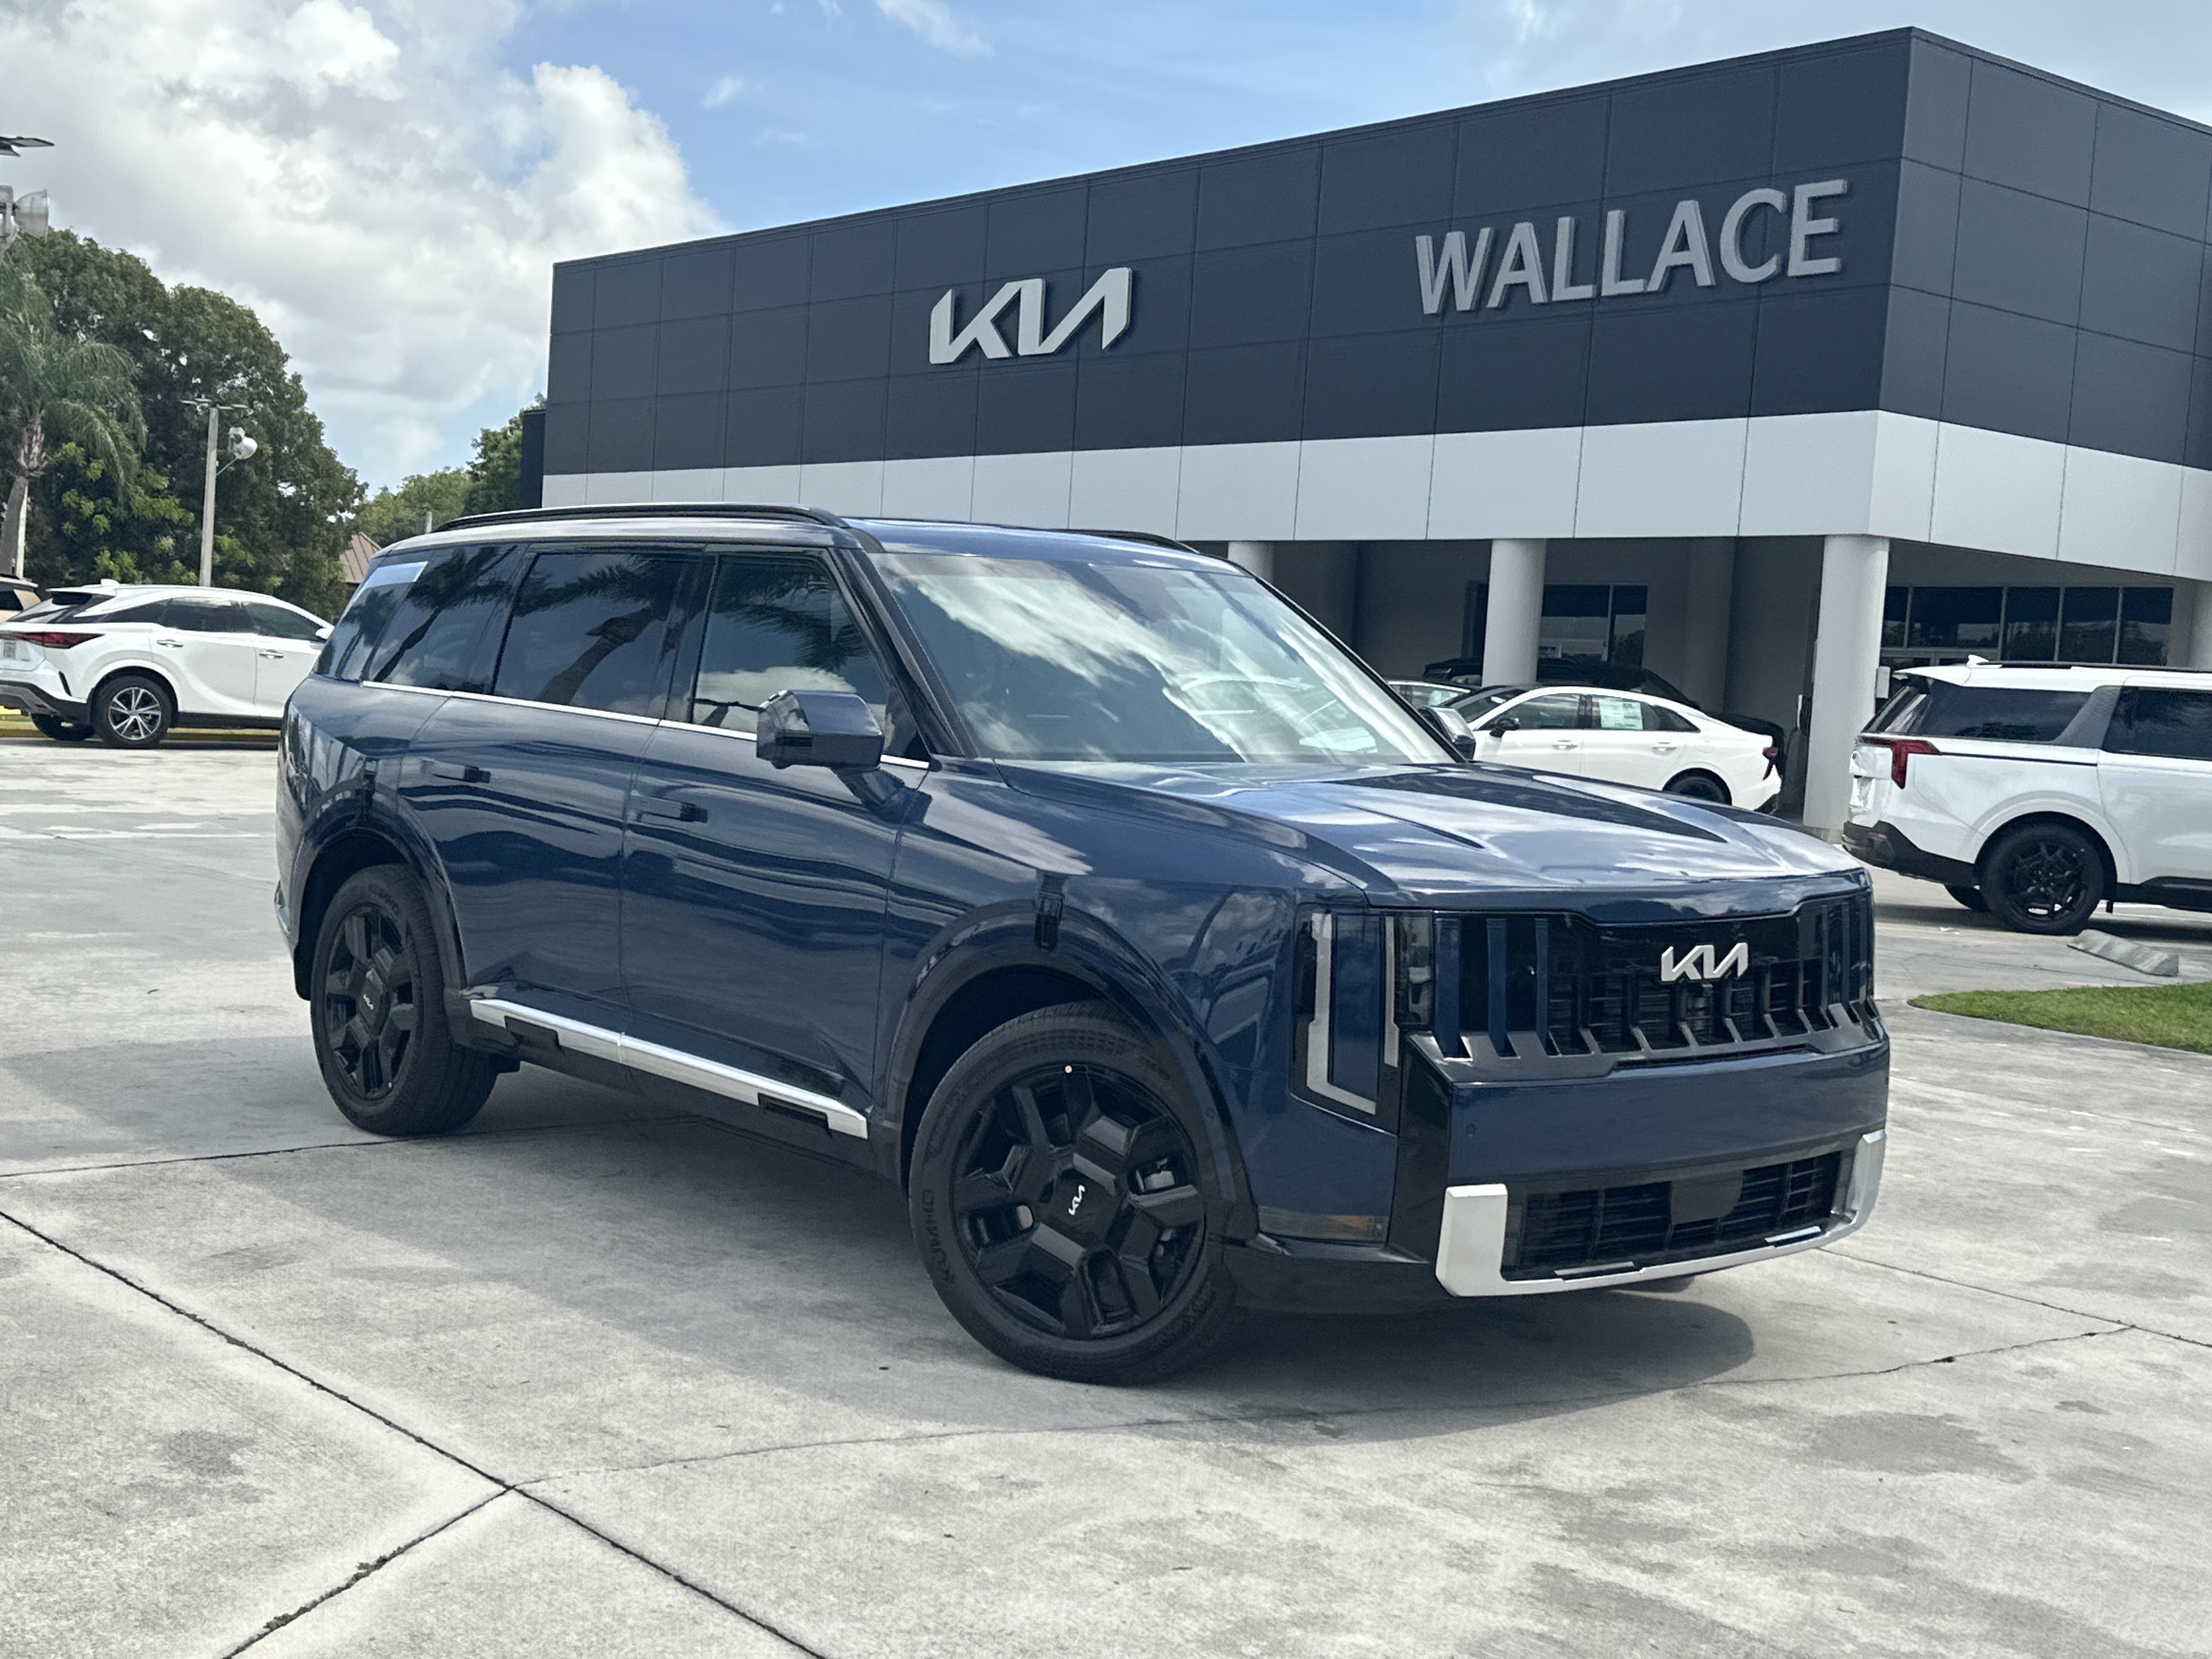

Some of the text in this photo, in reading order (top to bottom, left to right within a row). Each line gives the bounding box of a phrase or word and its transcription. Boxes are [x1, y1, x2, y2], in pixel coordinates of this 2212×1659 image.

[1415, 179, 1848, 315] WALLACE
[929, 267, 1132, 364] KIA
[1661, 941, 1748, 982] KIA
